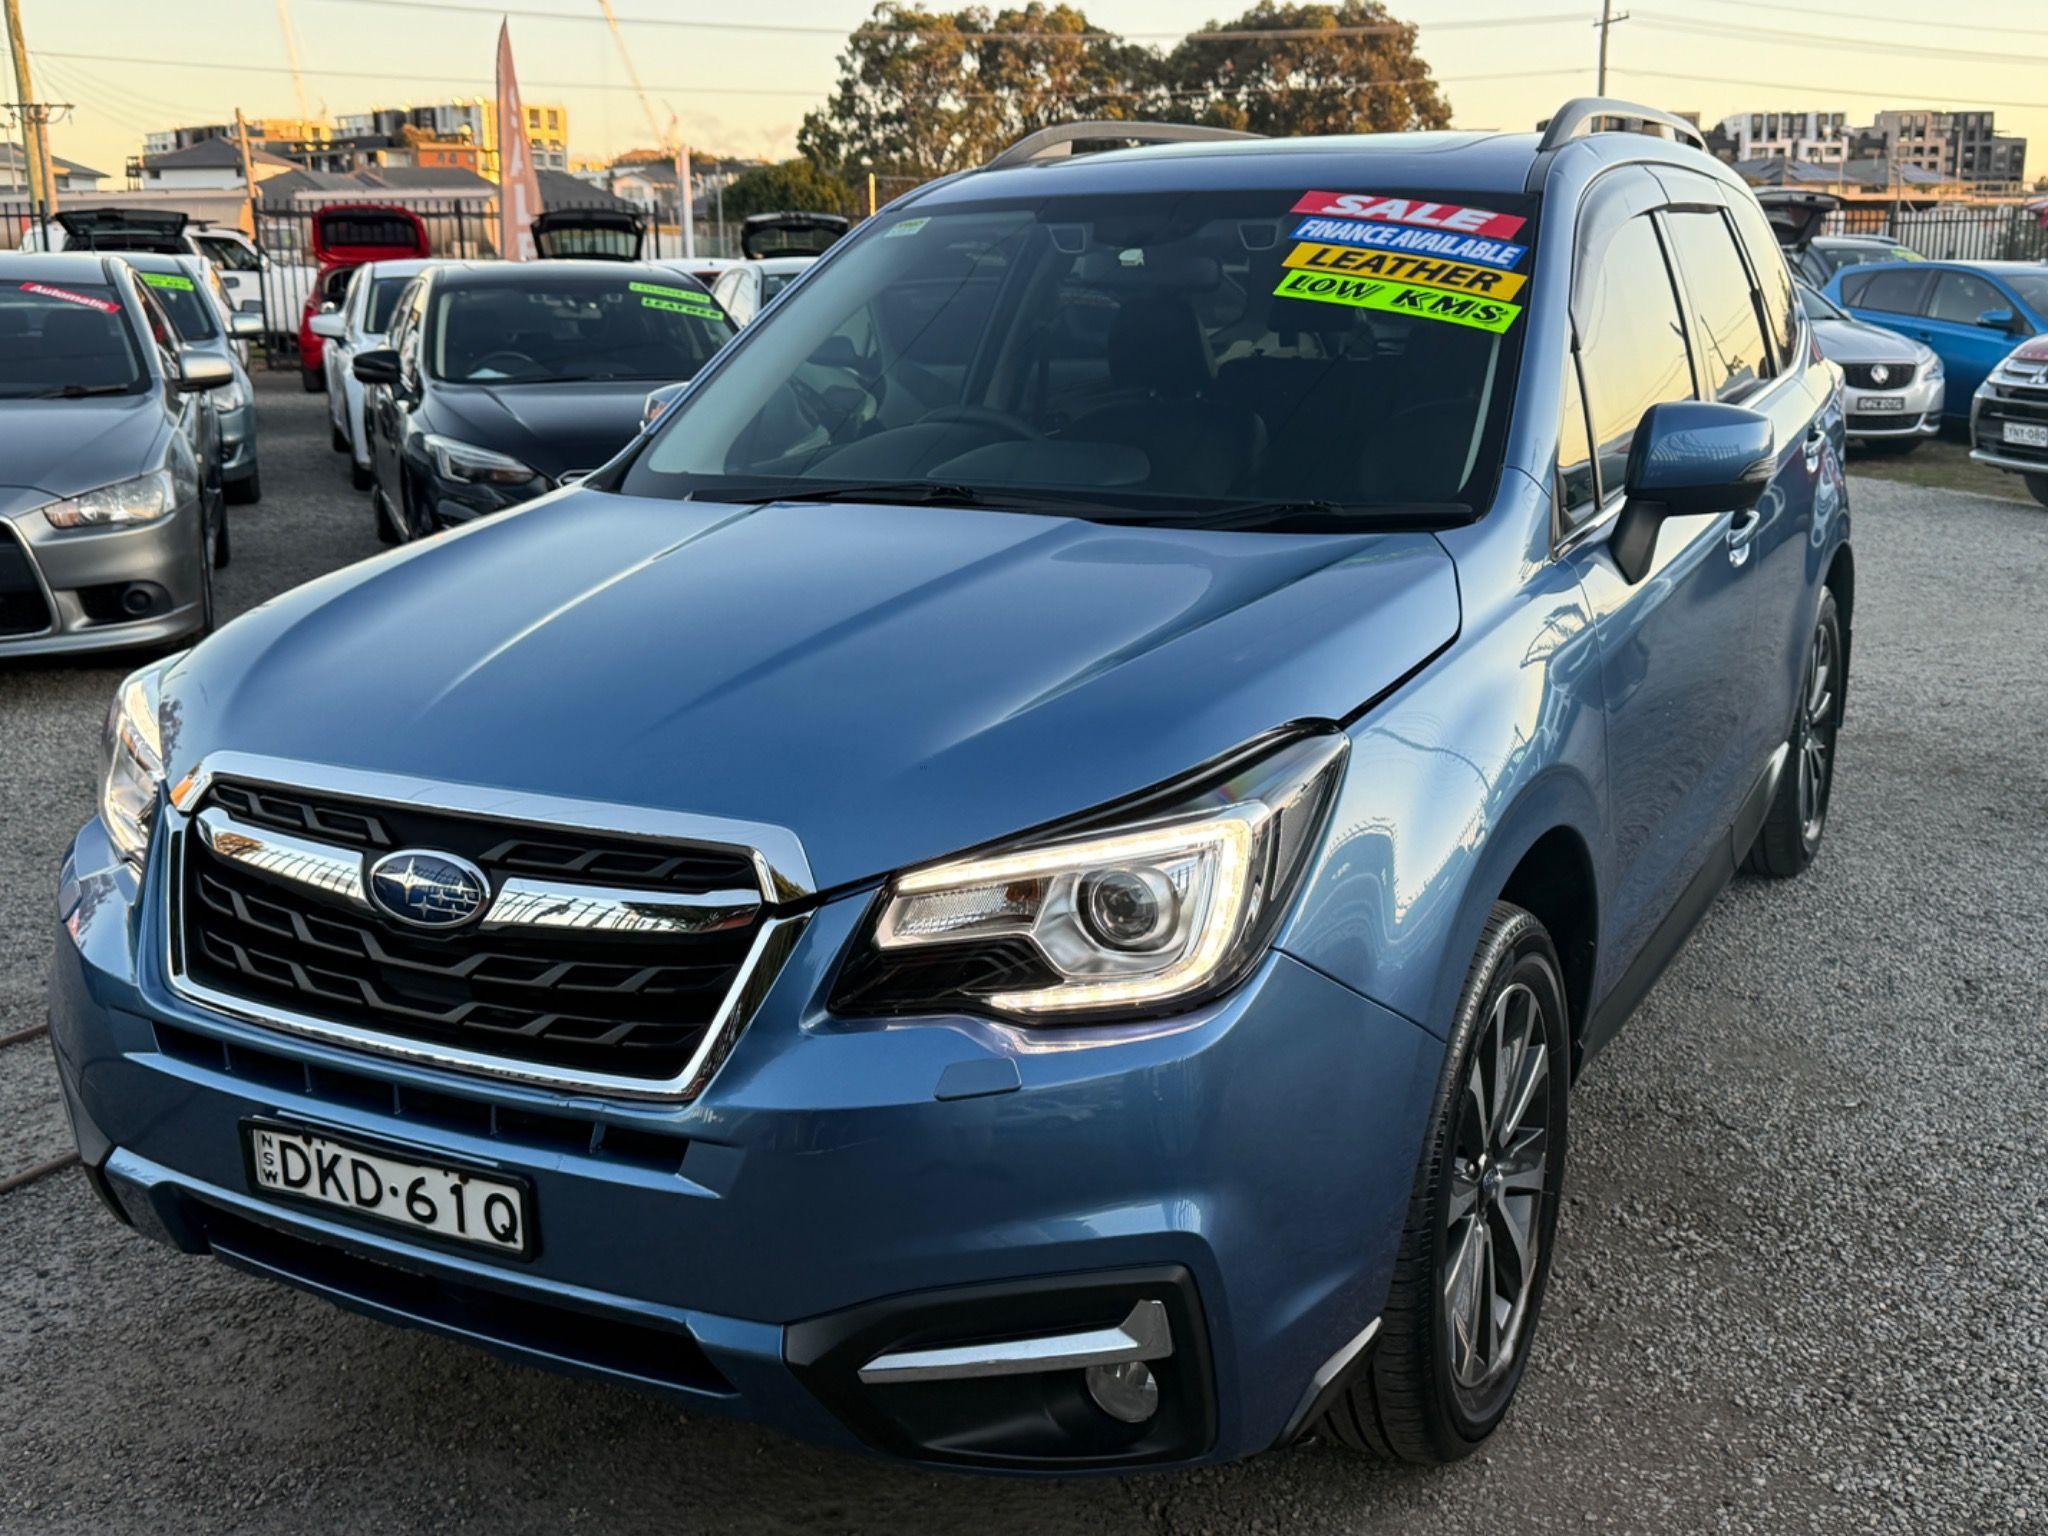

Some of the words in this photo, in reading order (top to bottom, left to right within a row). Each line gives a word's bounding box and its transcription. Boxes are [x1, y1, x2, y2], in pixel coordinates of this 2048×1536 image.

[1321, 194, 1498, 232] SALE
[1297, 218, 1402, 247] FINANCE
[1390, 230, 1520, 265] AVAILABLE
[1306, 247, 1503, 292] LEATHER
[30, 284, 110, 311] Automatic
[1286, 274, 1385, 299] LOW
[1390, 288, 1510, 323] KMS
